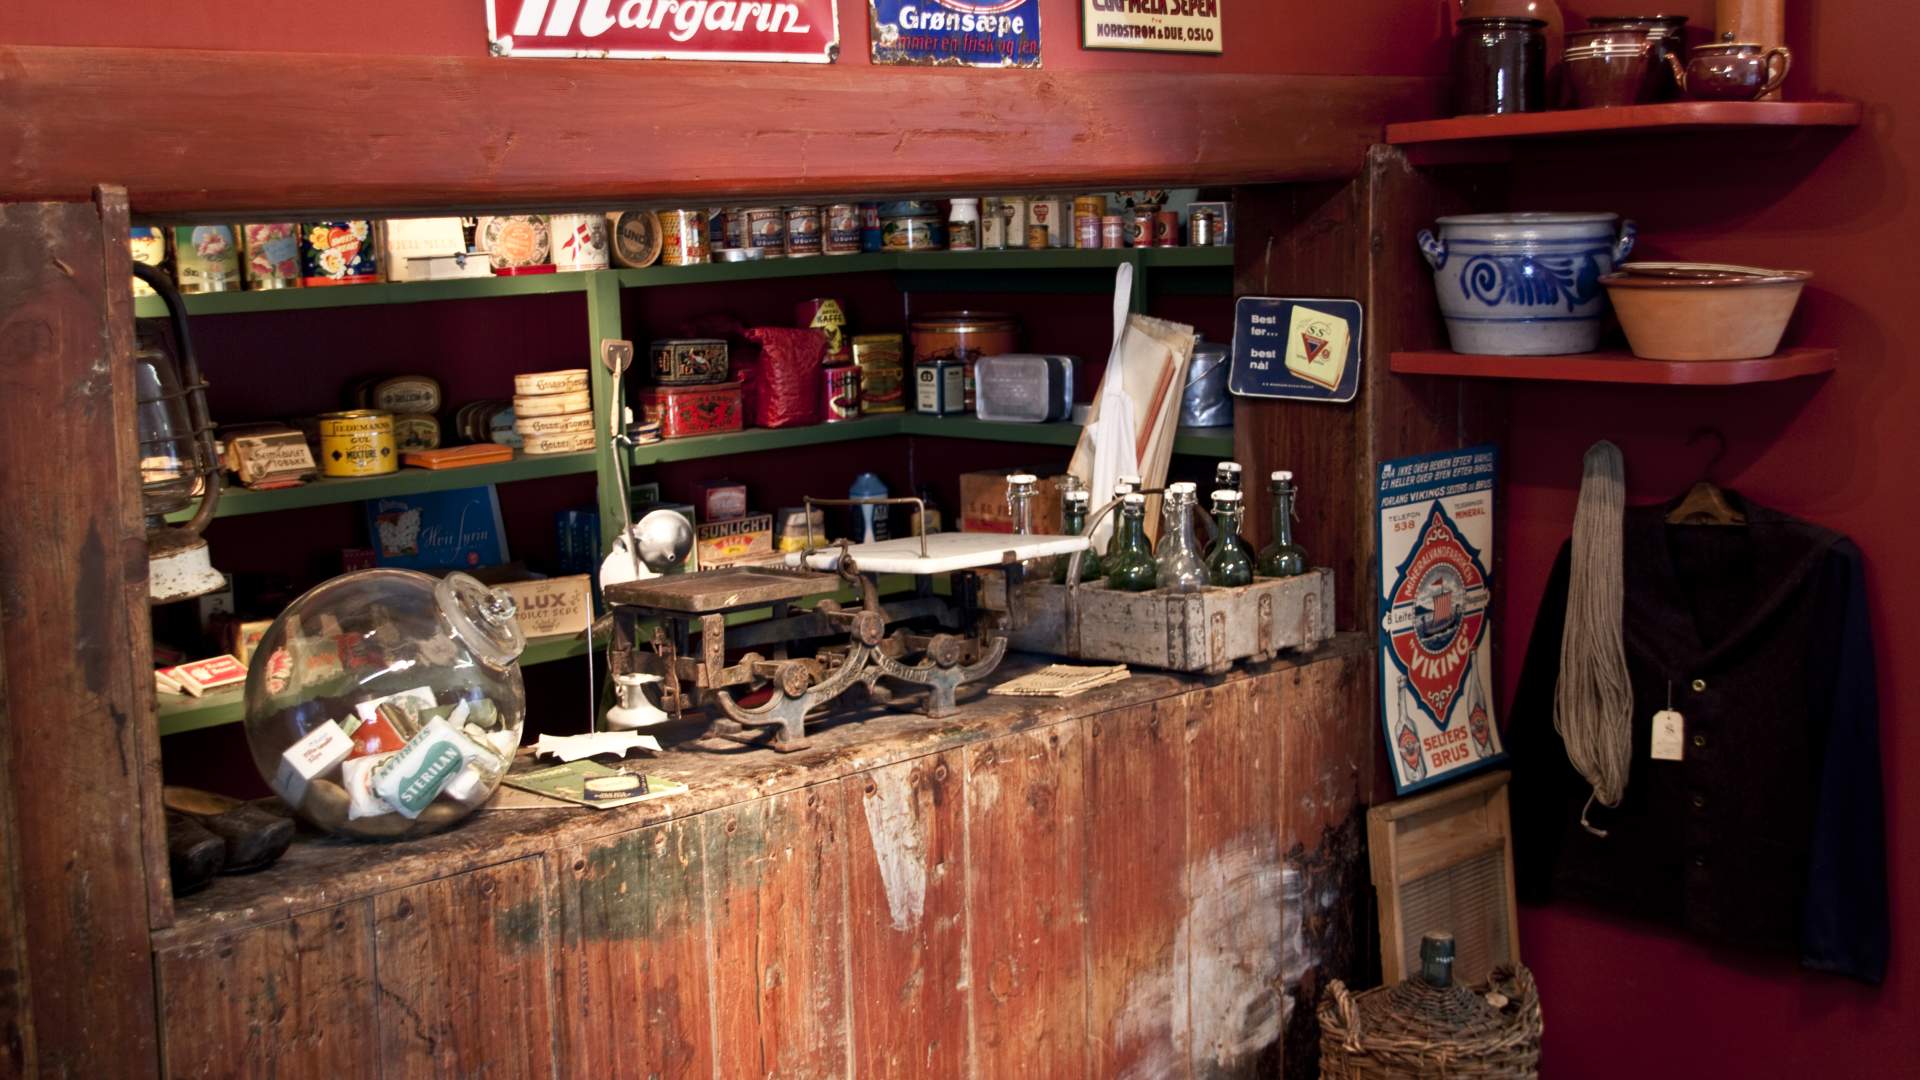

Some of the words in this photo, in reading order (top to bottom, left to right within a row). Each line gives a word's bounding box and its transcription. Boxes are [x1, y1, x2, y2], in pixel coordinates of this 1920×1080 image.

[899, 6, 1024, 38] Grønsæpe
[1187, 27, 1214, 42] OSLO
[1251, 314, 1276, 324] Best
[1251, 348, 1276, 359] best
[1410, 485, 1446, 502] VIKINGS
[1388, 511, 1421, 523] TELEFON
[700, 518, 769, 539] SUNLIGHT
[1393, 520, 1416, 533] 538
[523, 591, 567, 609] LUX
[1424, 725, 1468, 751] SELTERS
[1431, 743, 1469, 768] BRUS
[400, 747, 458, 802] STERILAN
